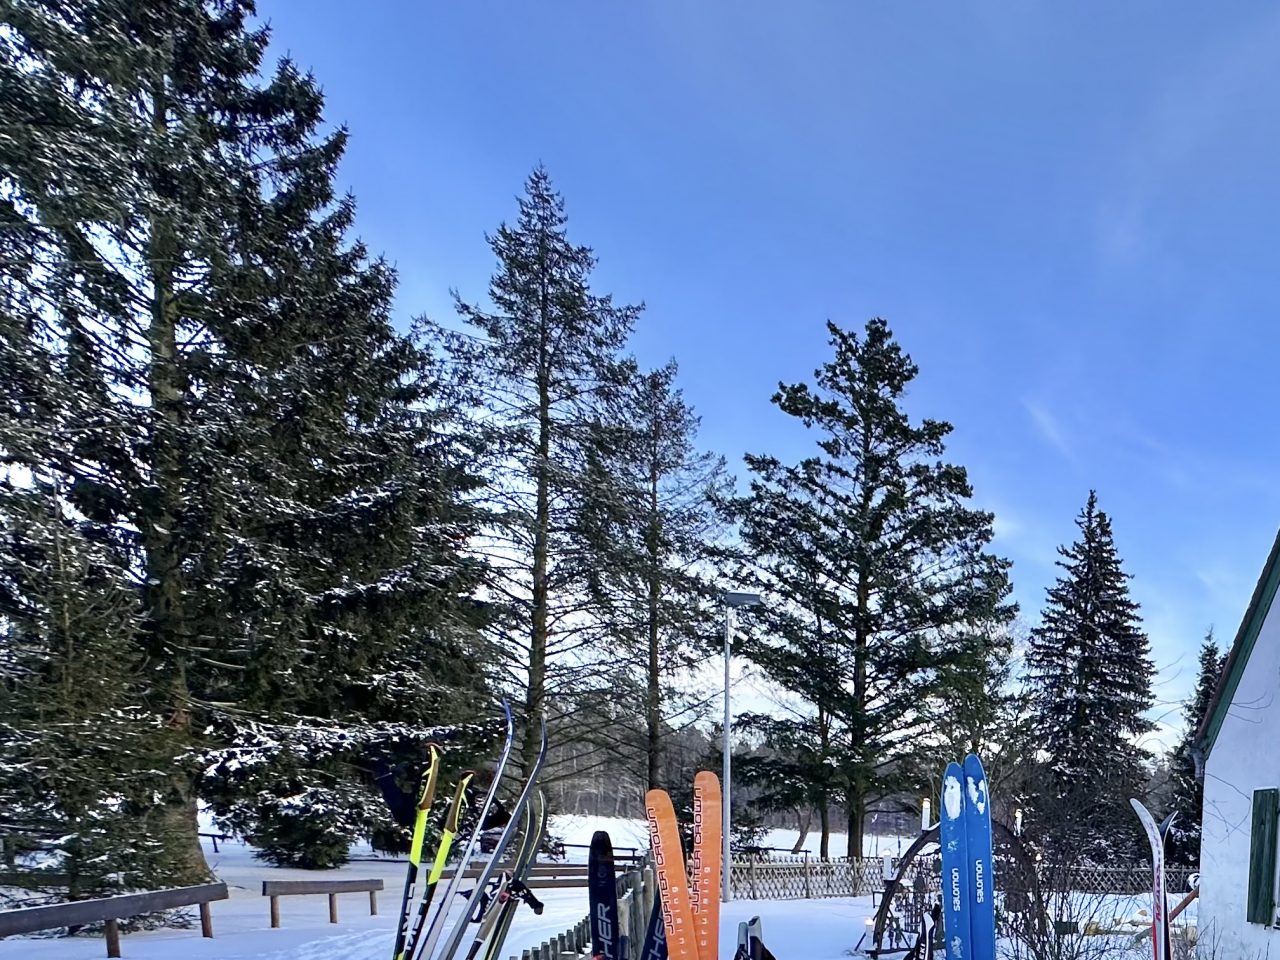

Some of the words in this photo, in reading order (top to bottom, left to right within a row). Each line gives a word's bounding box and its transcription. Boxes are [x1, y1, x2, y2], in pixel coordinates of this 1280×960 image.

[647, 807, 666, 867] CROWN
[693, 787, 703, 845] CROWN
[657, 870, 675, 935] JUPITER
[691, 850, 703, 914] JUPITER
[953, 868, 961, 912] salomon
[976, 859, 984, 904] salomon
